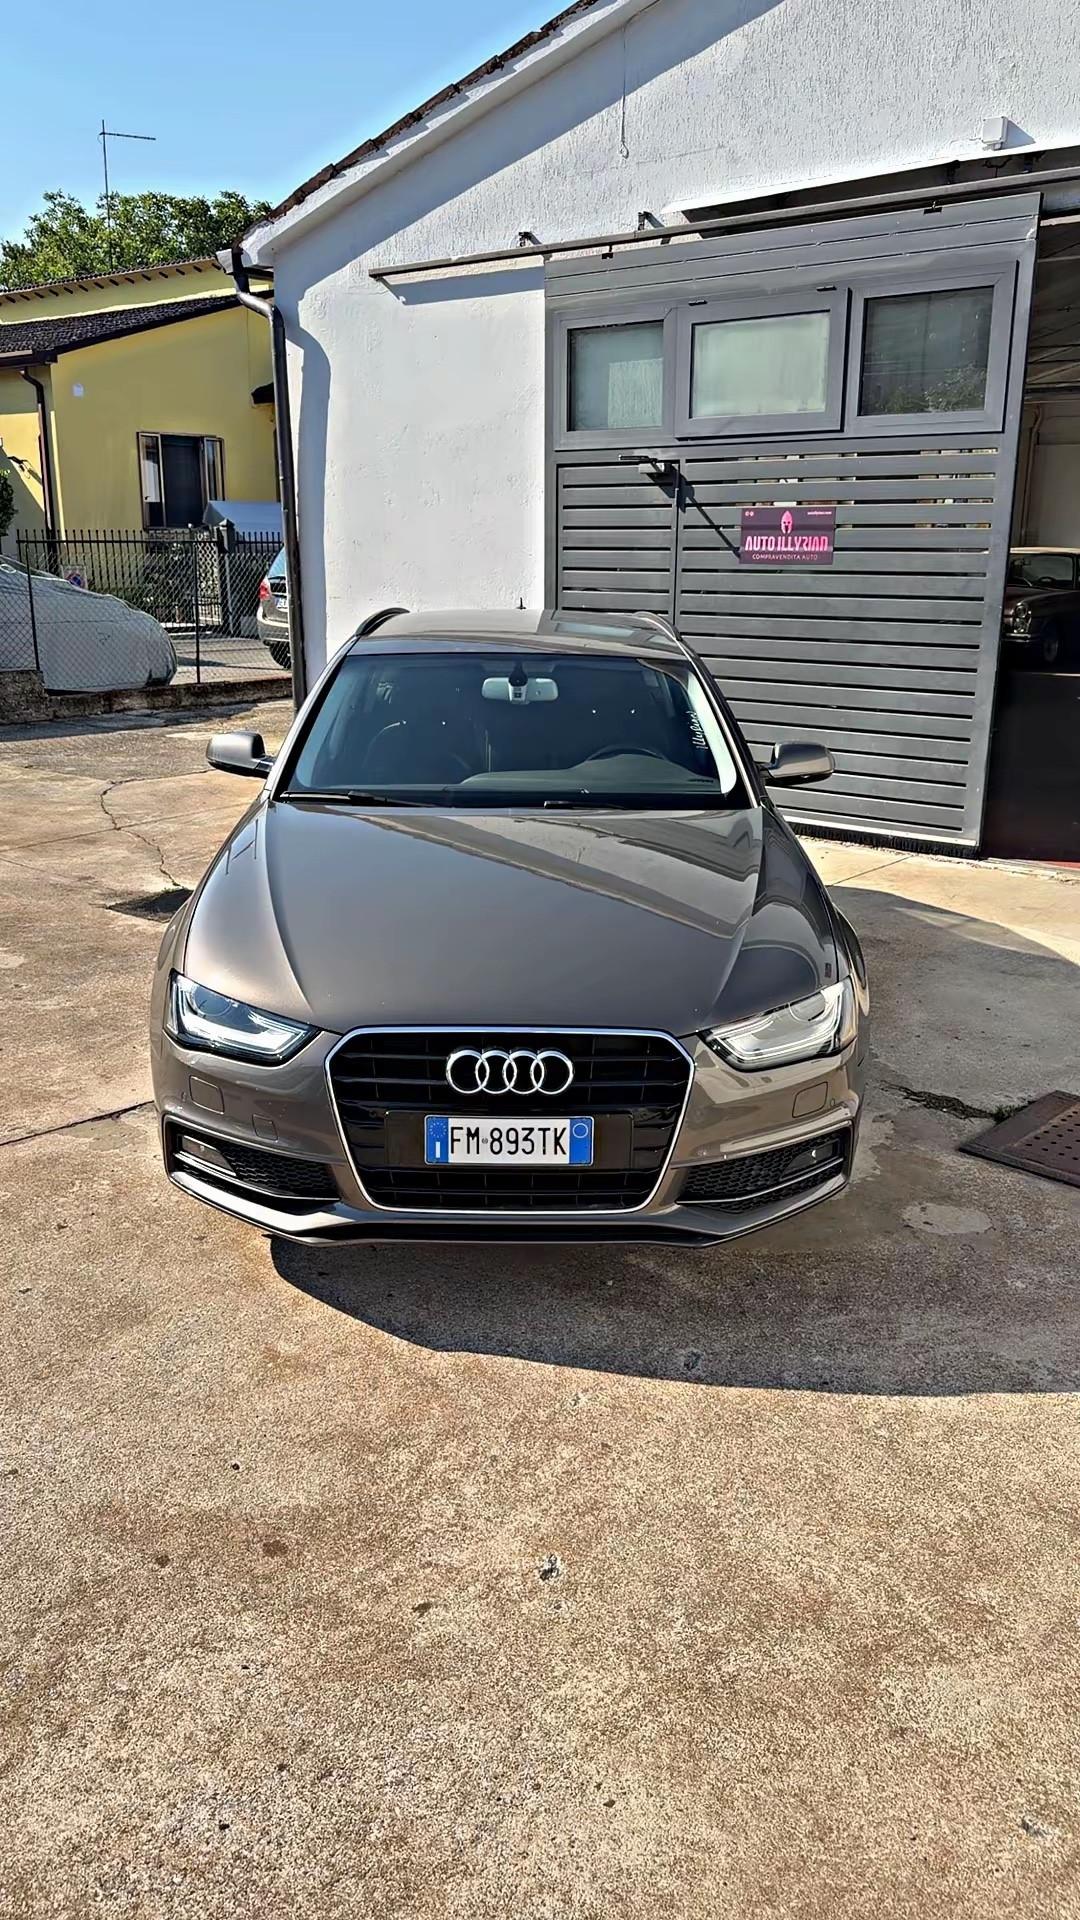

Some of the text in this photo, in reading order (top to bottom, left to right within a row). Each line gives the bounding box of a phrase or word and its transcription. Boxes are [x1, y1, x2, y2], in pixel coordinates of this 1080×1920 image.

[745, 536, 828, 551] AUTO ILLYRIAN
[801, 553, 818, 561] AUTO
[450, 1126, 480, 1155] FM
[489, 1127, 567, 1155] 893TK
